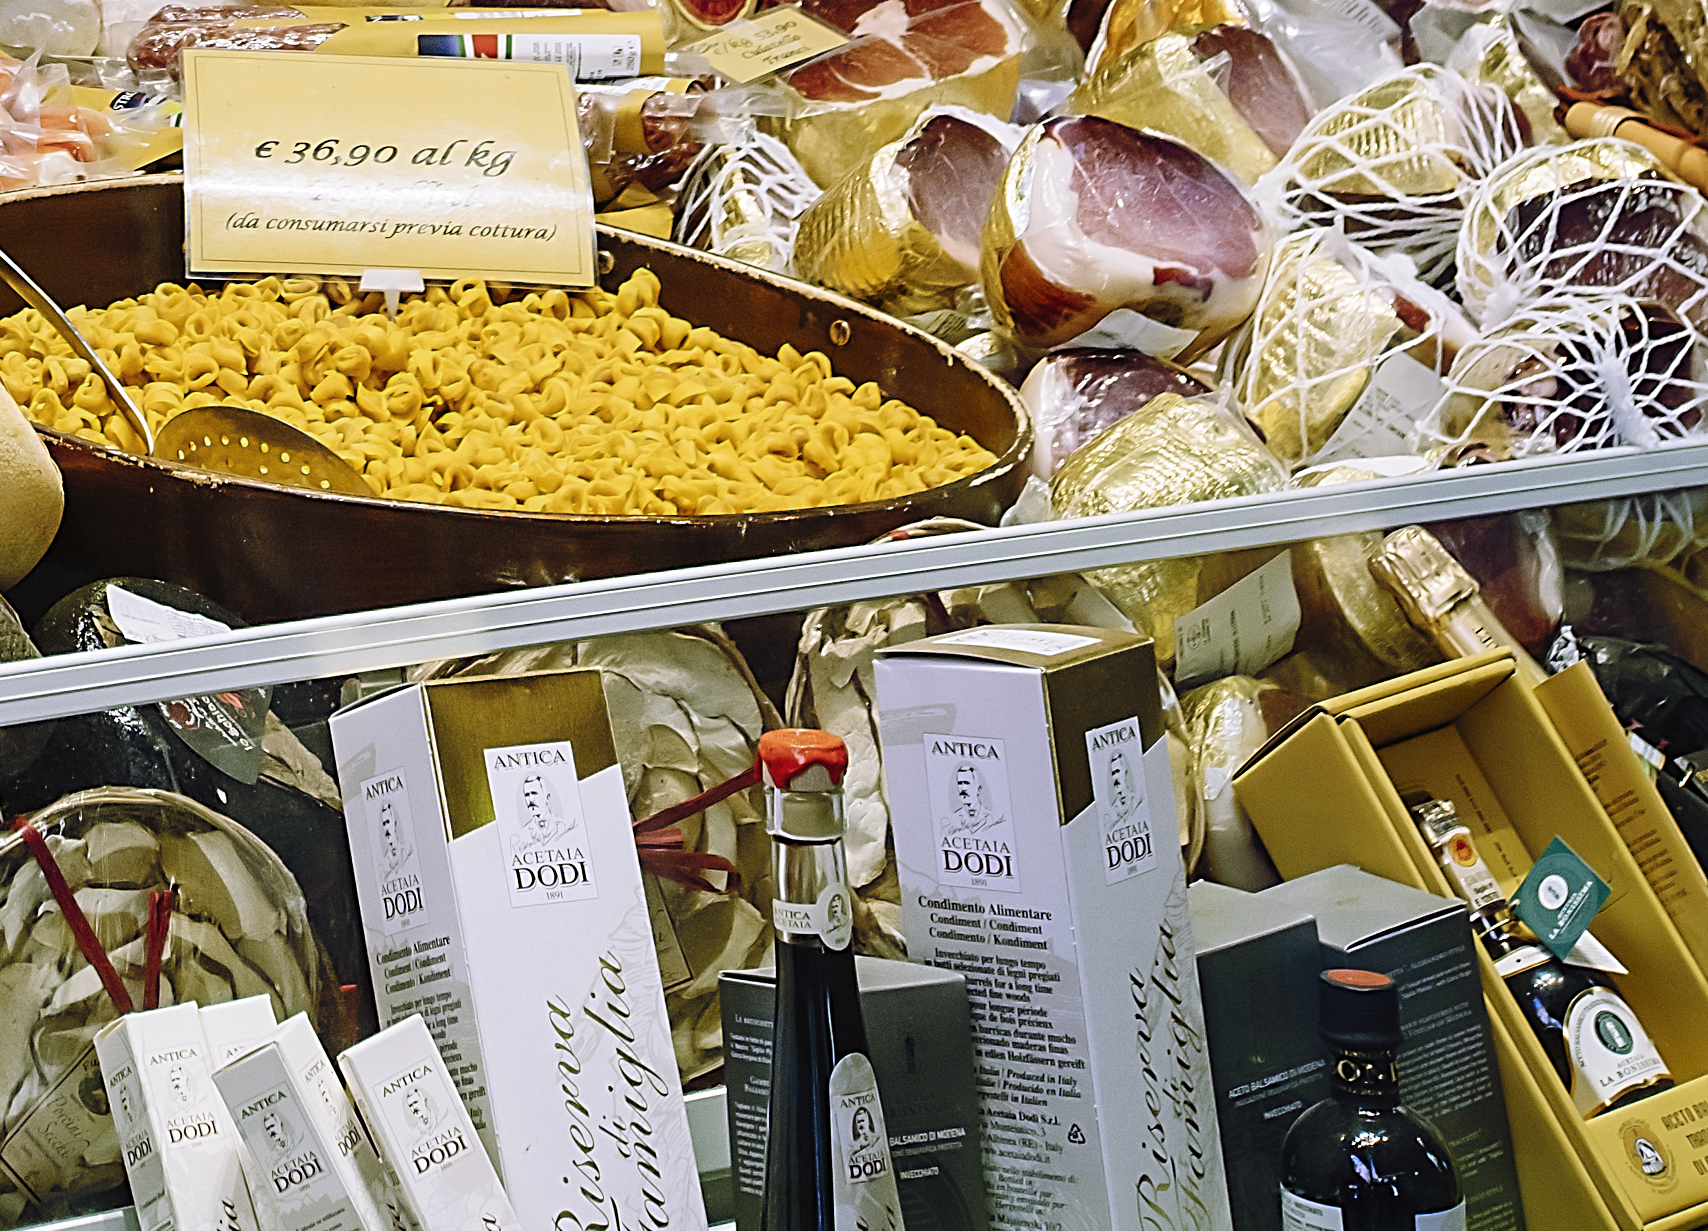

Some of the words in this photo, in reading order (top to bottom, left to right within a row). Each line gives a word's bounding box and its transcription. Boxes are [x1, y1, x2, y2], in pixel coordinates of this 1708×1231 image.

[255, 139, 281, 160] €
[284, 138, 398, 167] 36,90
[411, 138, 468, 167] al
[464, 139, 518, 178] kg
[225, 211, 261, 232] (da
[266, 216, 388, 235] consumarsi
[385, 220, 463, 241] previa
[469, 222, 557, 242] cottura)
[932, 740, 1001, 761] ANTICA
[1092, 725, 1137, 752] ANTICA
[493, 747, 568, 772] ANTICA
[365, 775, 405, 801] ANTICA
[941, 836, 1011, 854] ACETAIA
[1105, 820, 1150, 846] ACETAIA
[511, 846, 586, 867] ACETAIA
[942, 849, 1015, 879] DODI
[1106, 833, 1154, 872] DODI
[381, 873, 421, 897] ACETAIA
[513, 860, 590, 892] DODI
[971, 877, 988, 888] 1891
[383, 887, 424, 921] DODI
[546, 889, 565, 901] 1891
[918, 895, 986, 915] Condimento
[989, 903, 1053, 922] Alimentare
[930, 912, 982, 929] Condiment
[989, 919, 1043, 935] Condiment
[376, 944, 413, 966] Condimento
[413, 934, 451, 956] Alimentare
[929, 927, 986, 944] Condimento
[993, 934, 1049, 951] Kondiment
[935, 947, 980, 963] Invecchiato
[981, 954, 994, 967] per
[995, 954, 1019, 969] lungo
[1020, 958, 1047, 972] tempo
[994, 978, 1006, 990] for
[1015, 980, 1033, 995] long
[1034, 983, 1054, 995] time
[997, 965, 1006, 977] di
[1006, 967, 1027, 980] legni
[1028, 971, 1061, 984] pregiati
[1005, 991, 1031, 1003] woods
[1000, 1014, 1016, 1026] bois
[1018, 1016, 1054, 1030] précieux
[1017, 1002, 1048, 1018] période
[979, 1023, 1012, 1038] barricas
[1013, 1028, 1046, 1042] durante
[1048, 1032, 1077, 1045] mucho
[149, 1047, 199, 1066] ANTICA
[1011, 1040, 1047, 1053] maderas
[1048, 1043, 1069, 1056] finas
[304, 1059, 327, 1084] ANTICA
[1058, 1056, 1086, 1071] gereift
[109, 1065, 133, 1089] ANTICA
[382, 1064, 433, 1098] ANTICA
[1002, 1079, 1045, 1095] Producido
[1046, 1088, 1057, 1097] en
[1058, 1087, 1082, 1099] Italia
[1006, 1068, 1046, 1084] Produced
[1047, 1074, 1056, 1085] in
[1057, 1074, 1078, 1089] Italy
[1599, 1074, 1615, 1088] LA
[840, 1093, 876, 1108] ANTICA
[1020, 1094, 1048, 1107] Italien
[1161, 1076, 1184, 1120] di
[1228, 1083, 1251, 1099] ACETO
[240, 1090, 288, 1120] ANTICA
[986, 1107, 1017, 1121] Acetaia
[1018, 1111, 1039, 1123] Dodi
[166, 1111, 217, 1129] ACETAIA
[168, 1120, 220, 1145] DODI
[338, 1126, 363, 1157] DODI
[411, 1126, 461, 1159] ACETAIA
[598, 1114, 633, 1160] di
[889, 1132, 928, 1147] BALSAMICO
[928, 1131, 937, 1141] DI
[937, 1127, 967, 1140] MODENA
[127, 1137, 153, 1168] DODI
[413, 1134, 469, 1175] DODI
[1018, 1136, 1039, 1150] (RE)
[1044, 1141, 1064, 1155] Italy
[270, 1150, 317, 1179] ACETAIA
[273, 1158, 324, 1194] DODI
[849, 1158, 888, 1180] DODI
[899, 1166, 940, 1180] INVECCHIATO
